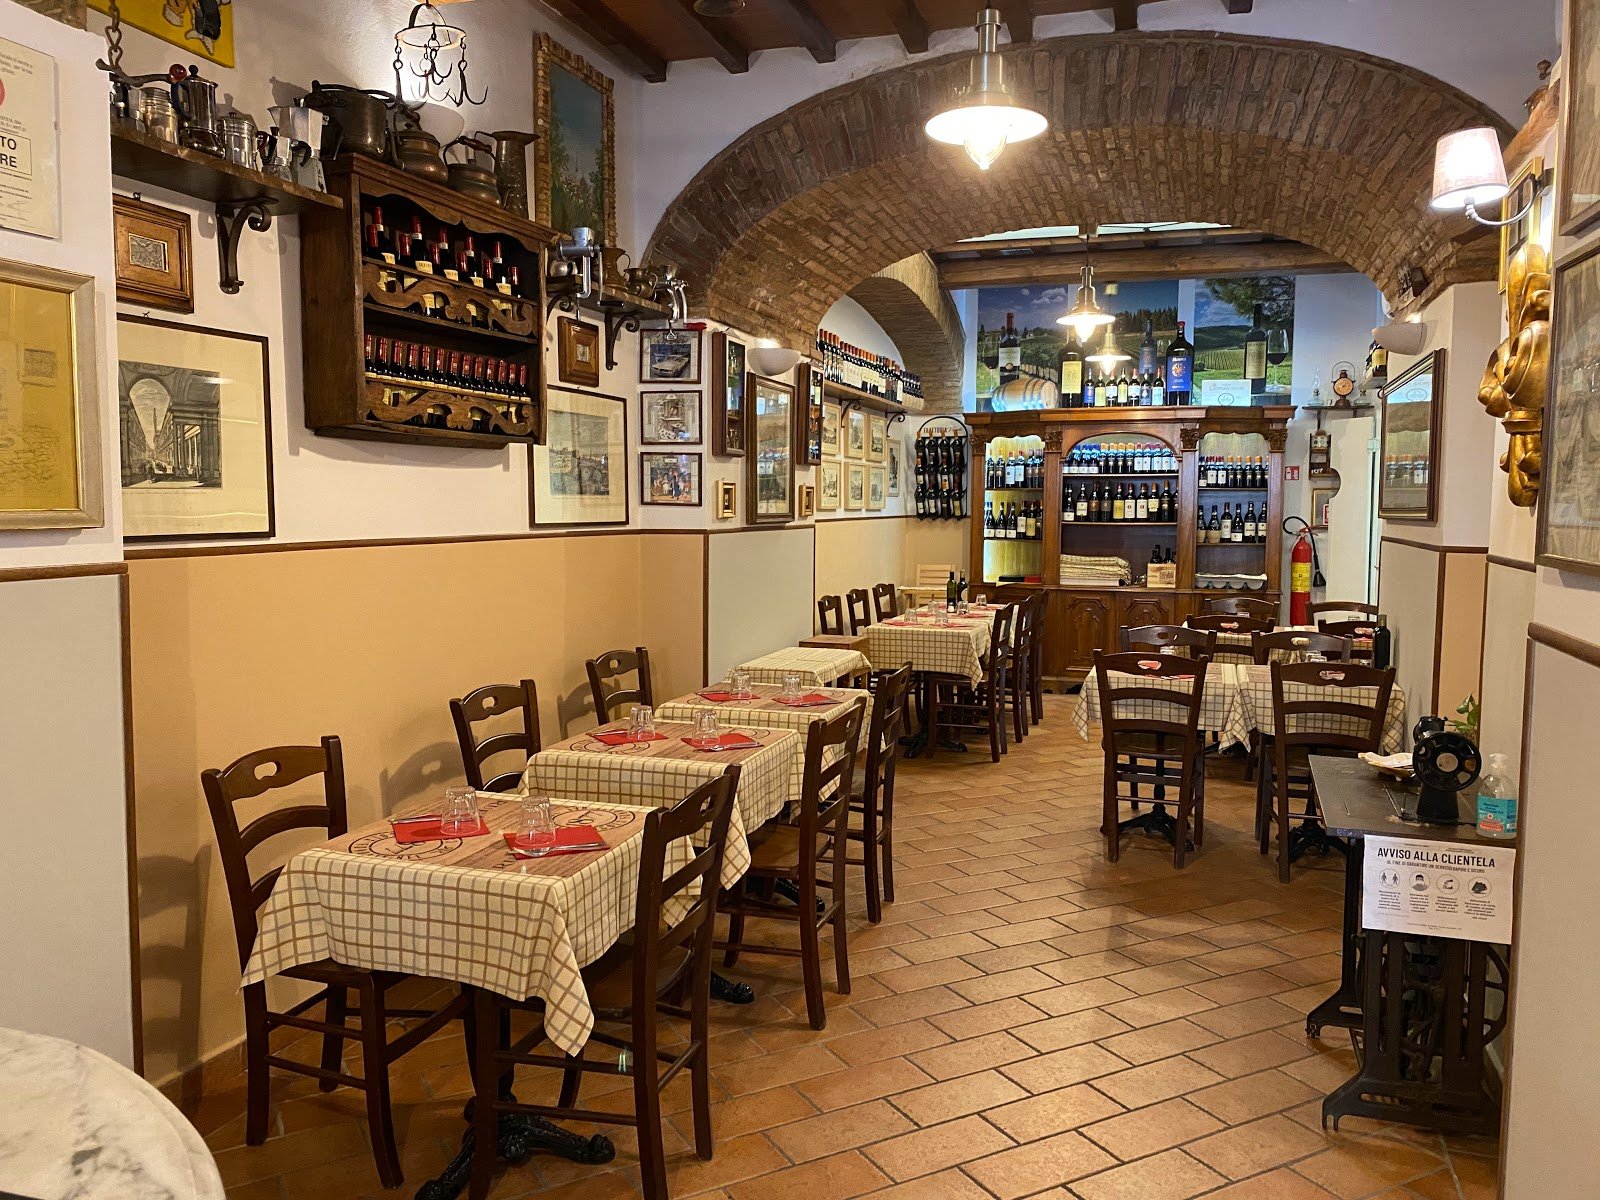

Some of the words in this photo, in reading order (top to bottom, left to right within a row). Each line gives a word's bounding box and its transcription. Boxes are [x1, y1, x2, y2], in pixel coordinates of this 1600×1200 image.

[1377, 847, 1411, 860] AVVISO
[1413, 850, 1438, 862] ALLA
[1441, 853, 1495, 868] CLIENTELA
